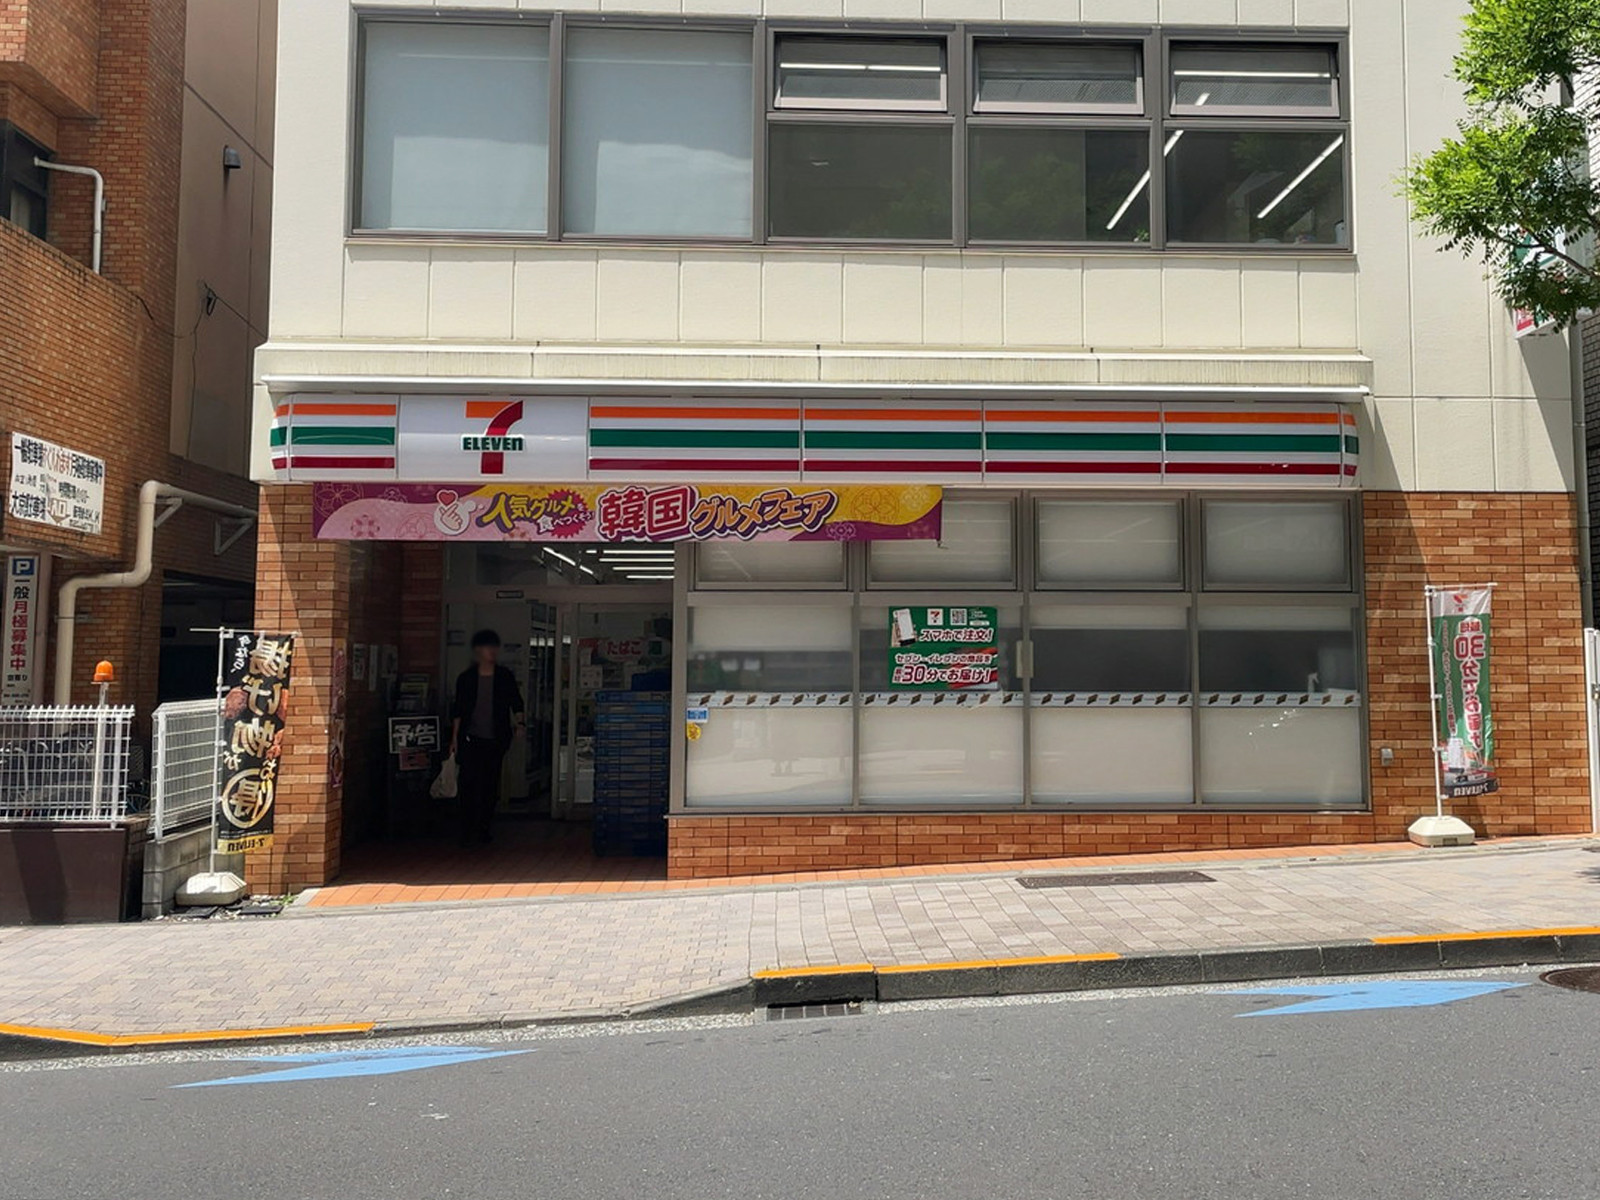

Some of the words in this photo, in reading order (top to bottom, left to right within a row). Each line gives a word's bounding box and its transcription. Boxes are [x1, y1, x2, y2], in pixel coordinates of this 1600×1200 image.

[465, 400, 523, 474] 7
[15, 560, 31, 574] P
[920, 628, 994, 642] スマホで注文!
[607, 641, 643, 656] たばこ
